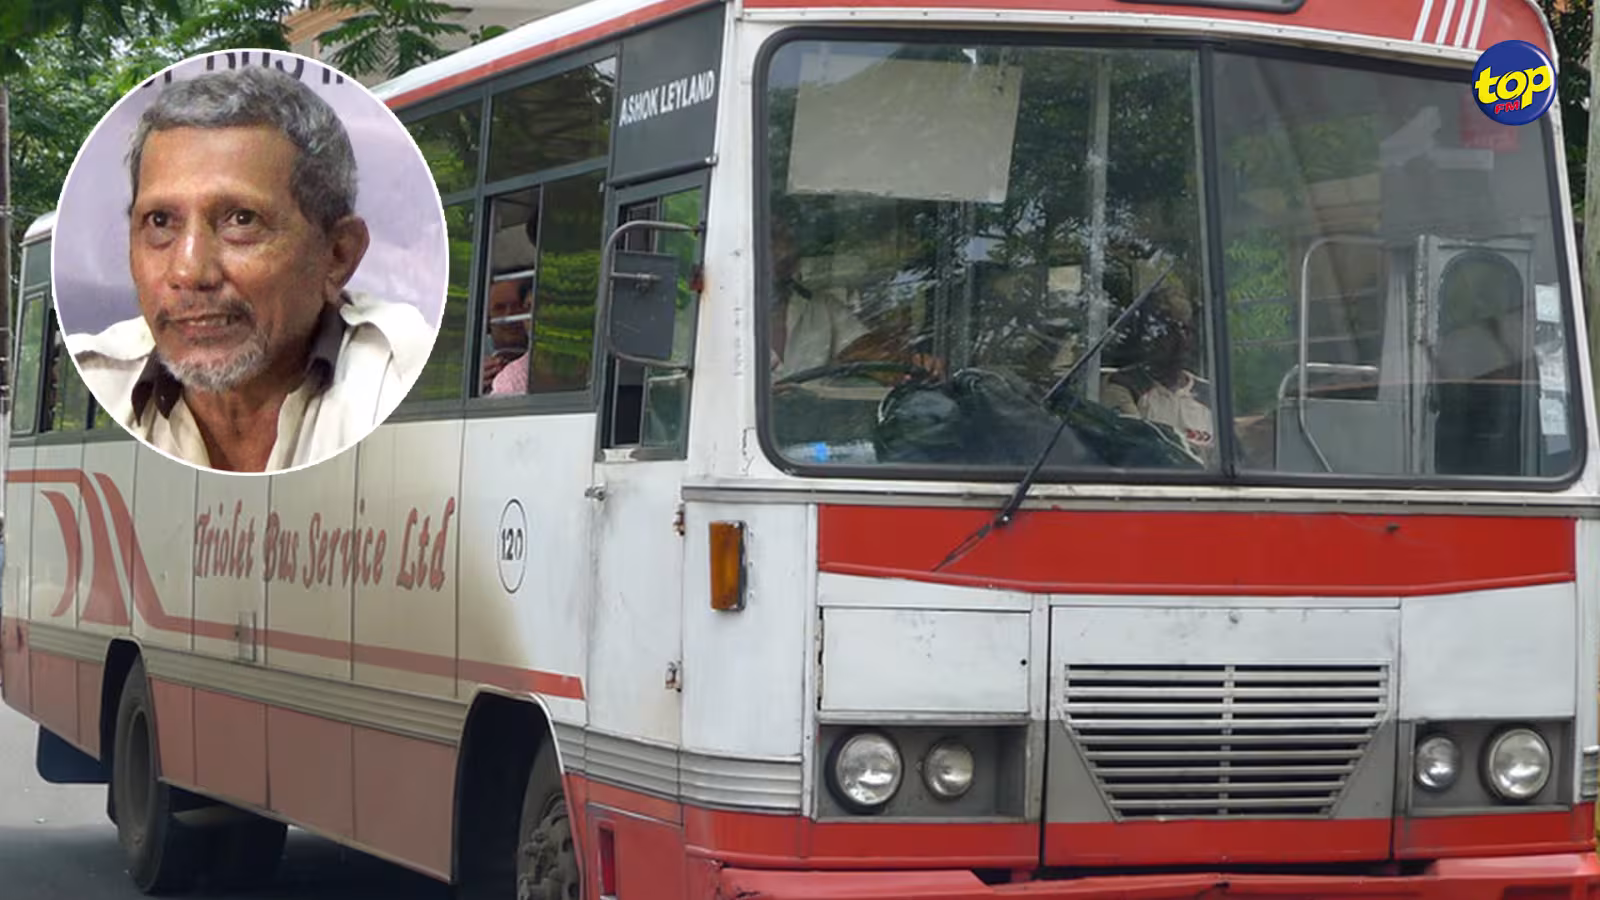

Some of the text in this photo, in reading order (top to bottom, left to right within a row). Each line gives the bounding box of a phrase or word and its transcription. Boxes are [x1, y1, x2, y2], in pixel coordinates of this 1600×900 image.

[618, 69, 715, 127] ASHOK LEYLAND
[194, 497, 455, 591] Triolet Bus Service Ltd
[501, 527, 524, 561] 120
